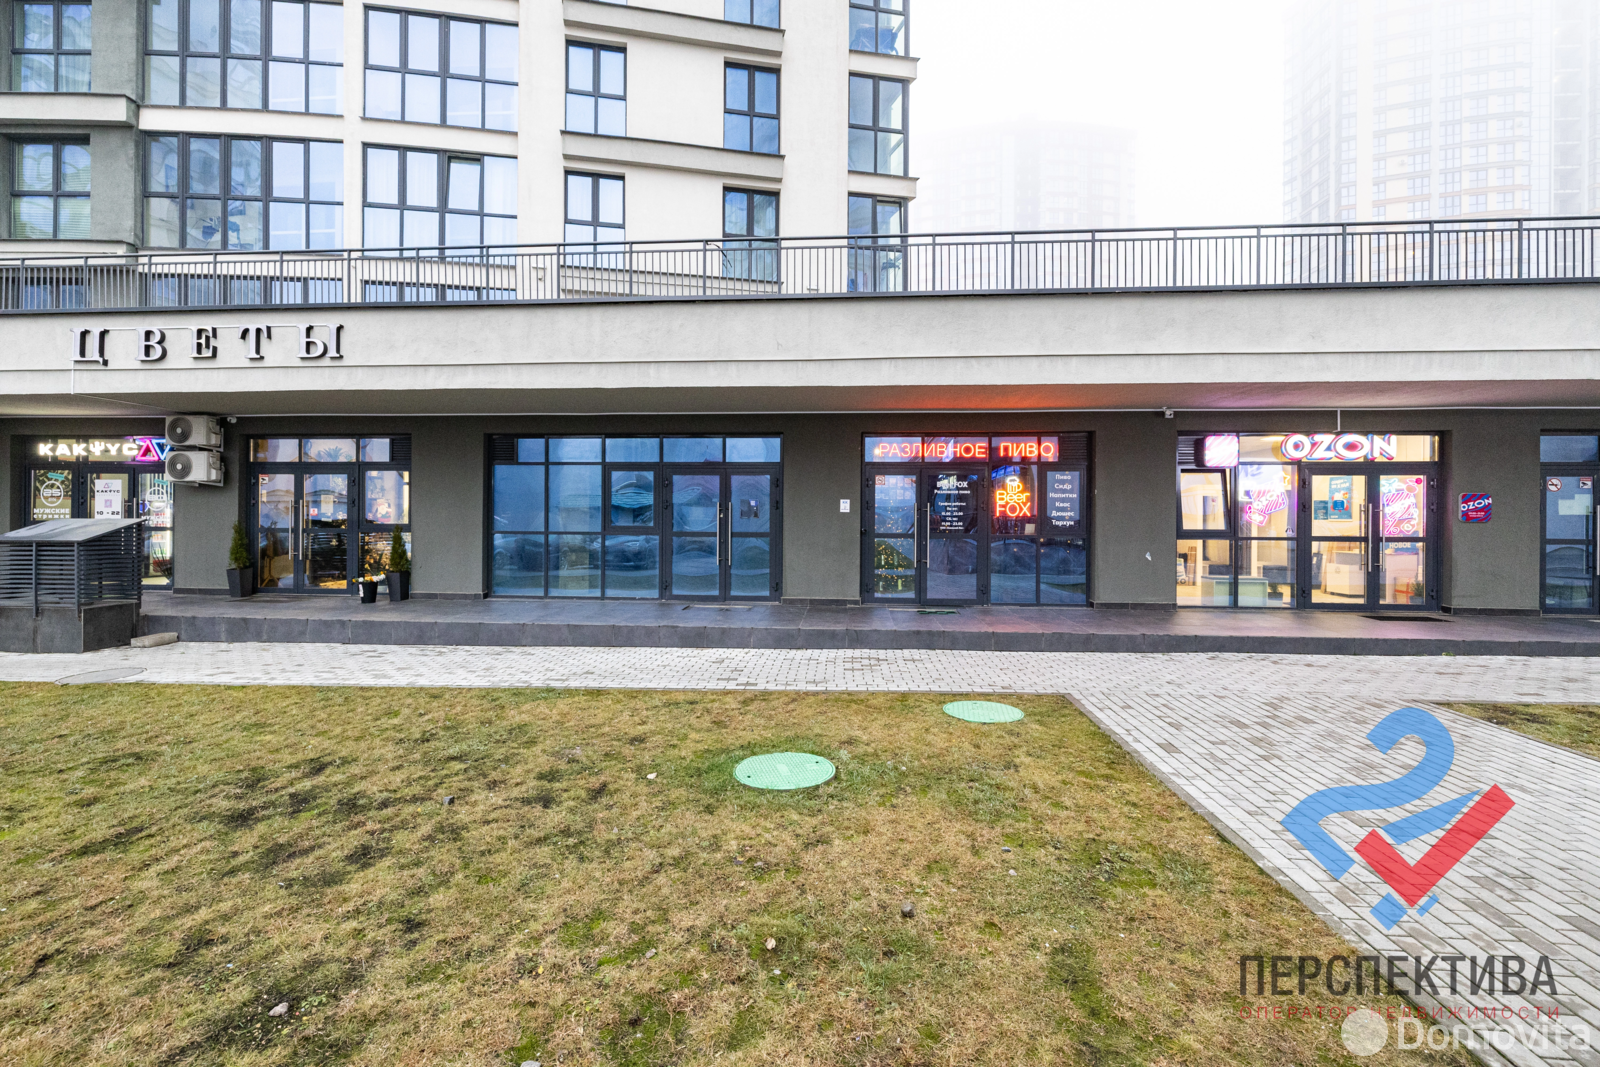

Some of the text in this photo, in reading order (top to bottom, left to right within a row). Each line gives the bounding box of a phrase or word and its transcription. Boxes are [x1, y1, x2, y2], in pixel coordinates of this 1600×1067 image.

[70, 323, 344, 367] ЦВЕТЫ
[878, 442, 1055, 458] РАЗЛИВНОЕ ПИВО
[1281, 433, 1397, 461] OZON
[996, 490, 1031, 503] Beer
[1461, 497, 1492, 511] OZON
[996, 502, 1031, 517] FOX
